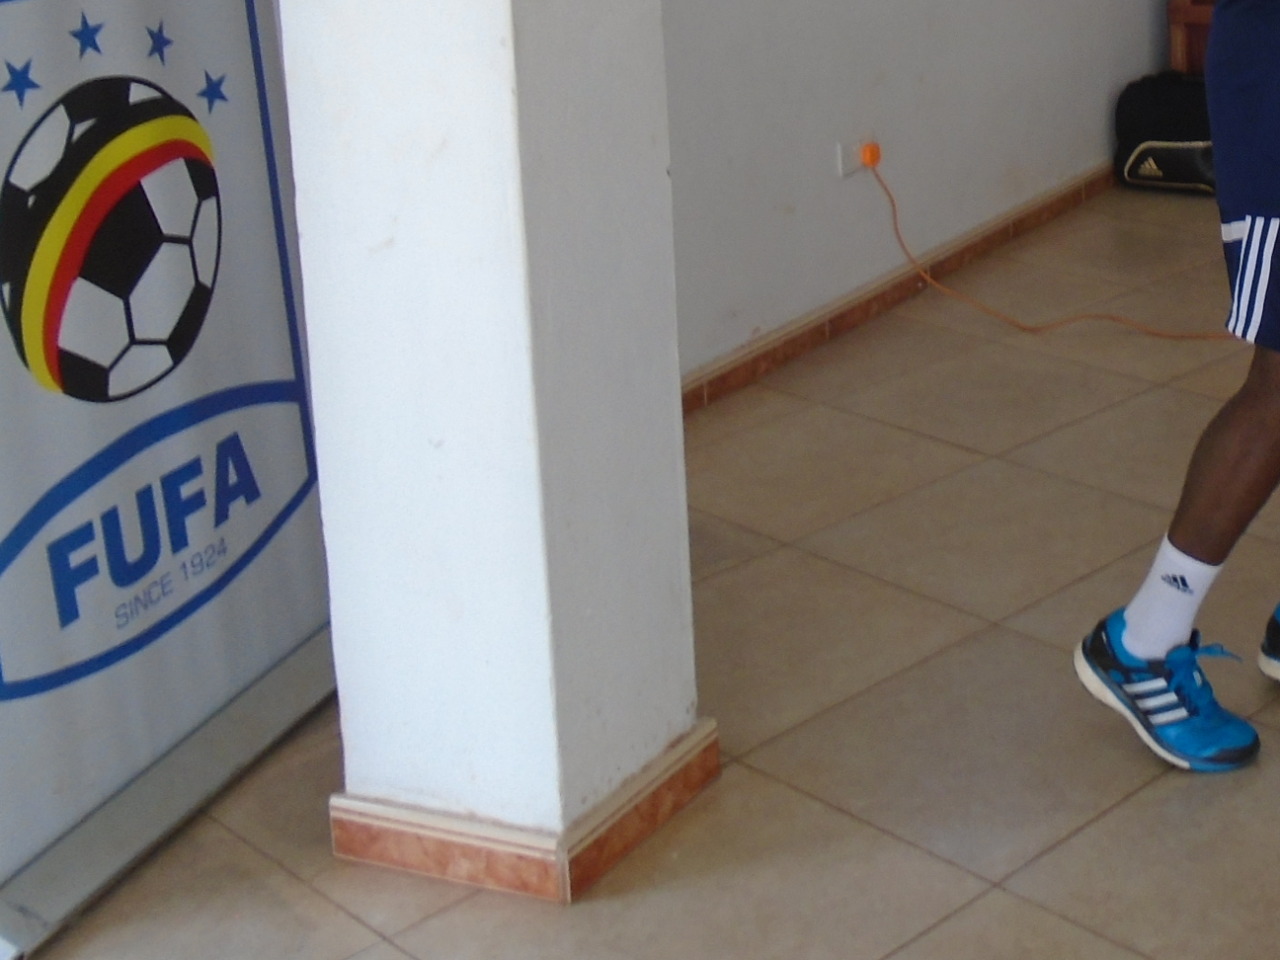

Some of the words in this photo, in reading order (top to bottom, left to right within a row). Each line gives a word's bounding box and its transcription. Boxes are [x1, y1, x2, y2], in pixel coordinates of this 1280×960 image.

[46, 431, 262, 630] FUFA
[114, 571, 174, 630] SINCE
[179, 537, 229, 583] 1924
